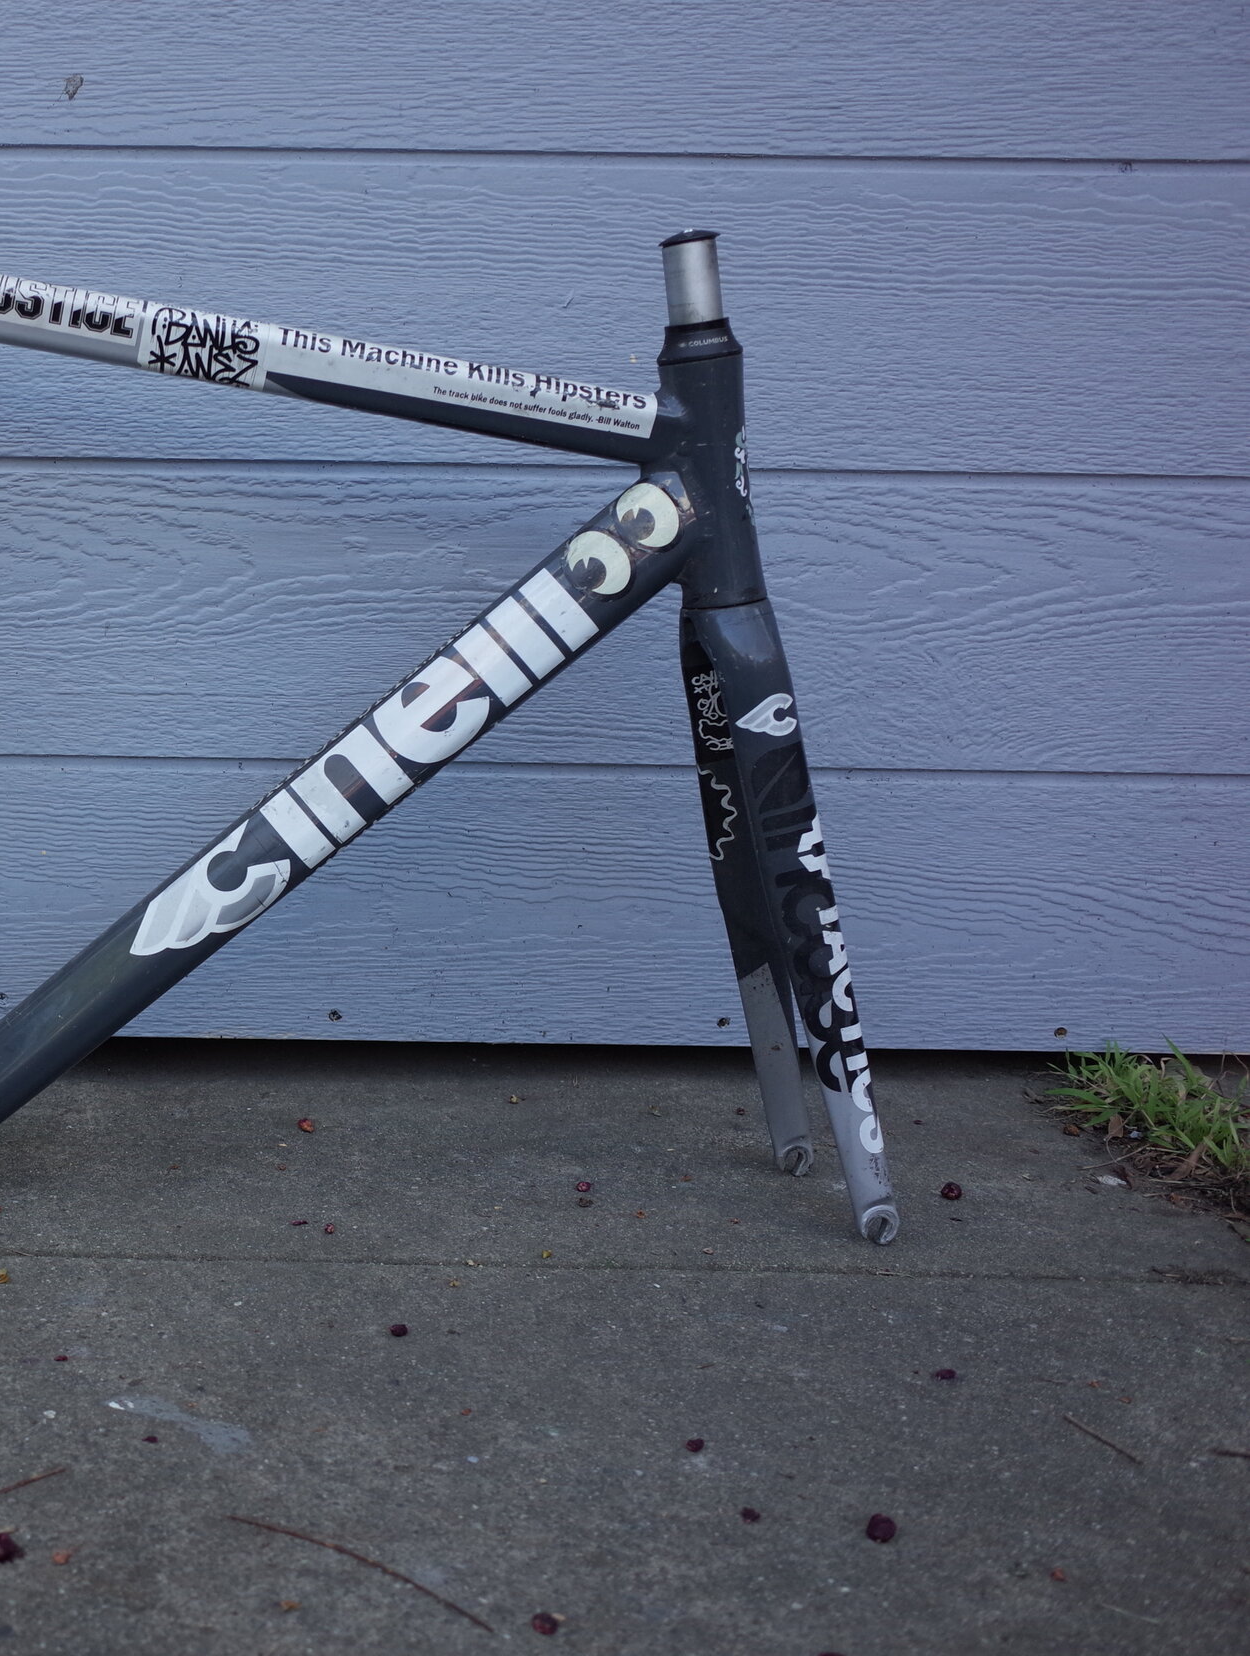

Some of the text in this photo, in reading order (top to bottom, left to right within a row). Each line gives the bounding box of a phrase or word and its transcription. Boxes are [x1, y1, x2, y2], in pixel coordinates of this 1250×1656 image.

[688, 335, 729, 348] COLUMBUS
[278, 327, 648, 410] This Machine Kills Hipsters
[433, 386, 447, 397] The
[449, 389, 469, 401] track
[471, 392, 488, 403] bike
[489, 396, 508, 407] does
[509, 400, 523, 410] not
[524, 403, 547, 414] suffer
[548, 406, 567, 418] fools
[568, 410, 594, 424] gladly.
[613, 418, 641, 430] Walton
